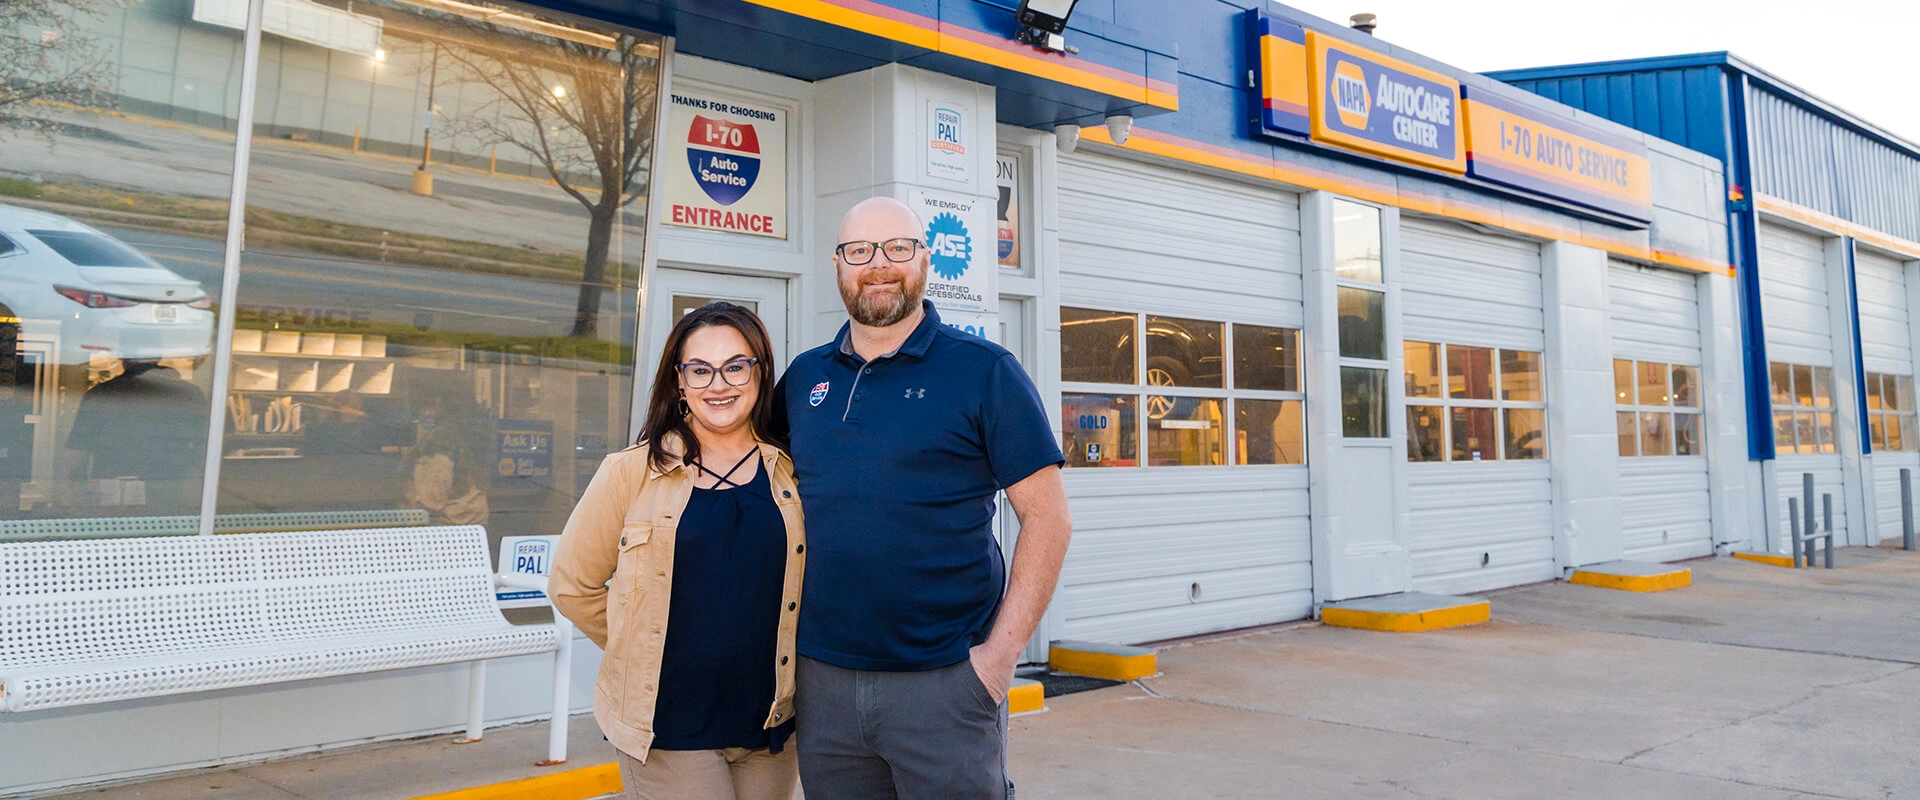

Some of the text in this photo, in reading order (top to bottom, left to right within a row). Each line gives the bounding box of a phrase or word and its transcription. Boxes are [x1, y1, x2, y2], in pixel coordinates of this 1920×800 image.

[1338, 76, 1367, 114] NAPA
[671, 94, 776, 121] THANKS FOR CHOOSING
[938, 112, 958, 124] REPAIR
[706, 123, 742, 147] I-70
[938, 122, 958, 143] PAL
[1393, 115, 1438, 149] CENTER
[1500, 120, 1627, 187] I-70 AUTO SERVICE
[710, 156, 739, 171] Auto
[701, 169, 747, 187] Service
[925, 198, 972, 213] WE EMPLOY
[672, 204, 773, 233] ENTRANCE
[931, 232, 966, 259] ASE
[926, 289, 983, 302] OFESSIONALS
[929, 282, 969, 294] CERTIFIED
[1080, 415, 1106, 429] GOLD
[503, 434, 548, 448] Ask Us
[518, 544, 546, 555] REPAIR
[517, 556, 543, 574] PAL
